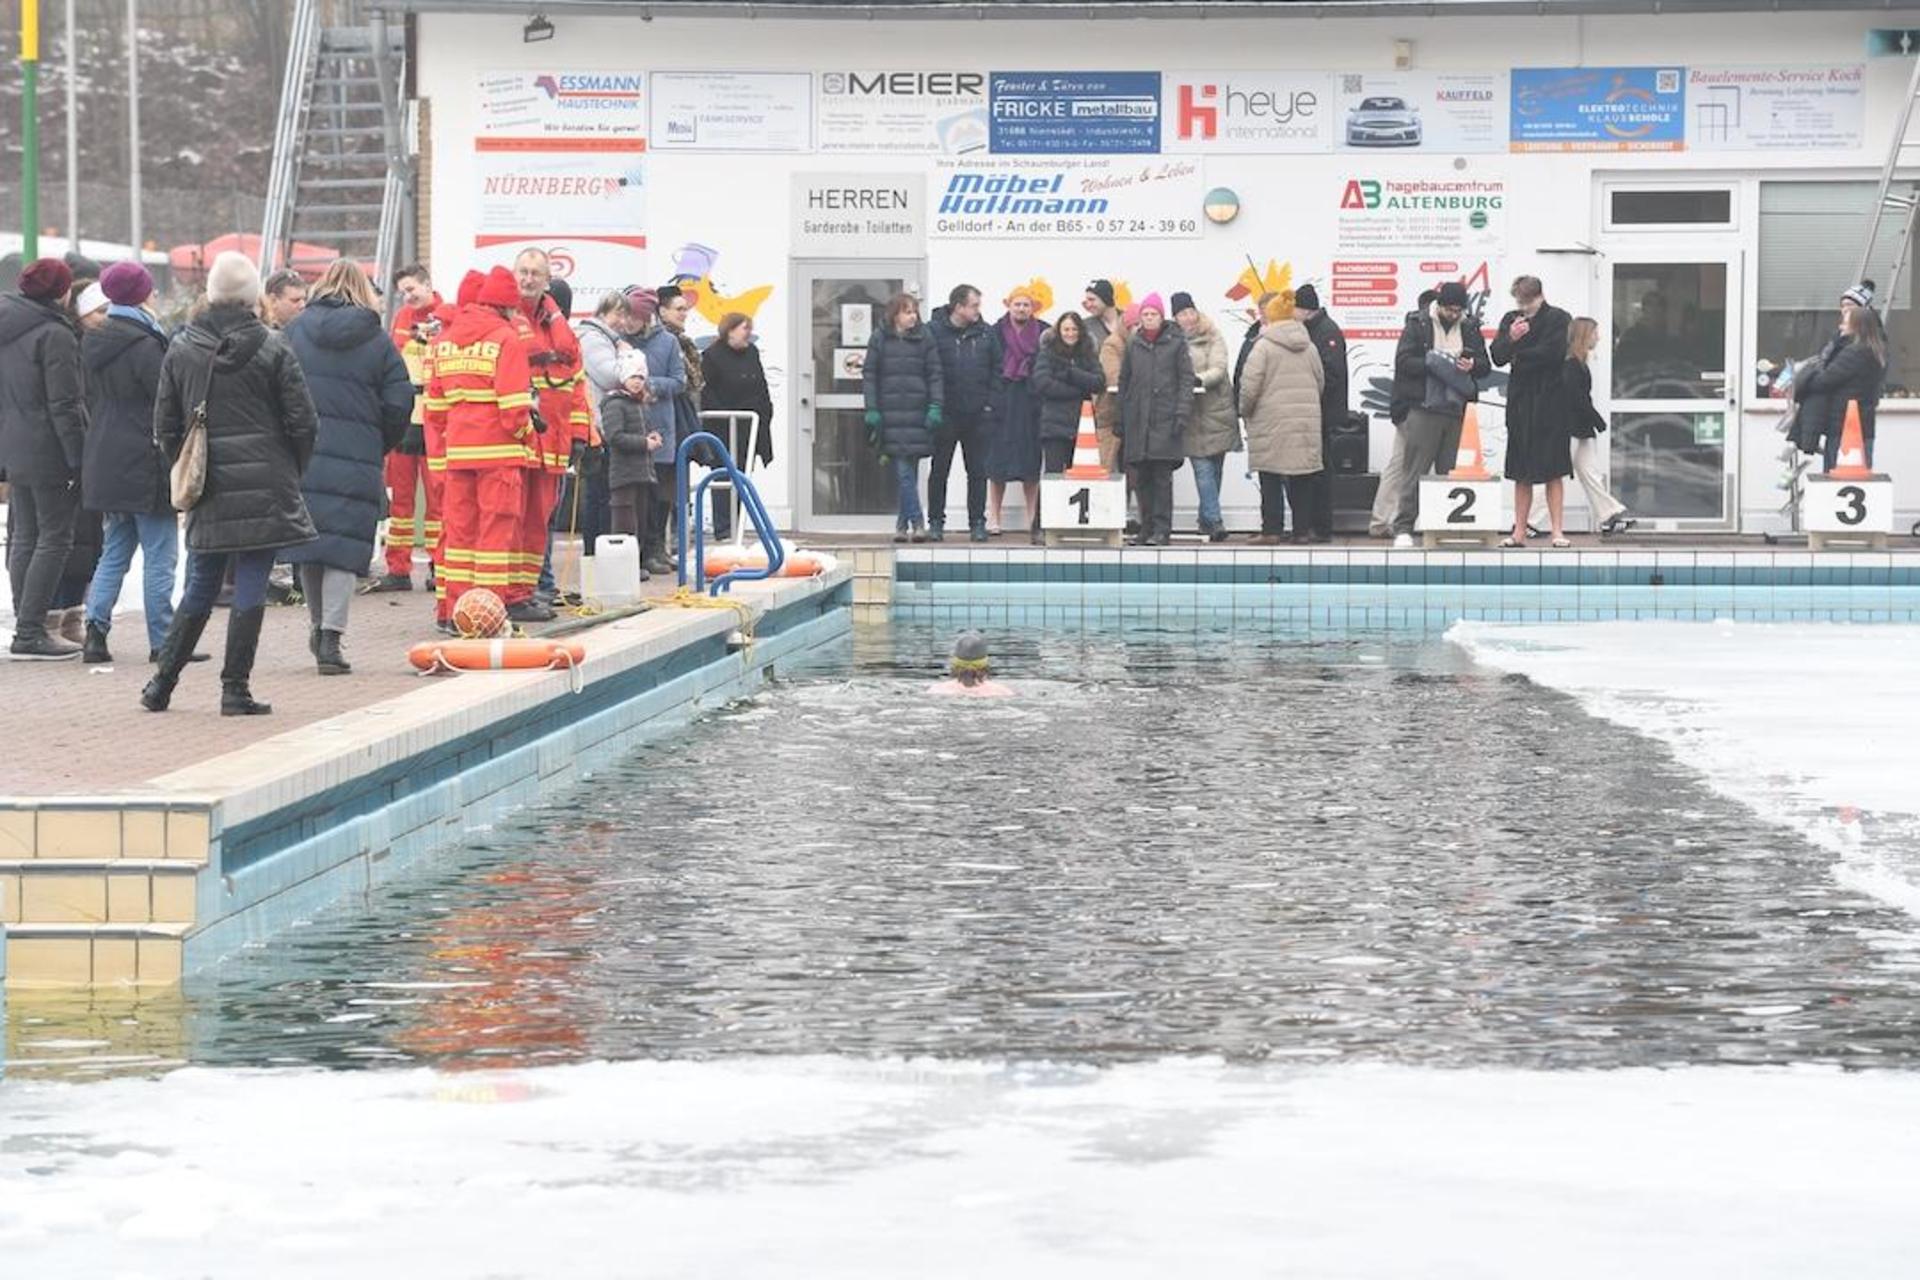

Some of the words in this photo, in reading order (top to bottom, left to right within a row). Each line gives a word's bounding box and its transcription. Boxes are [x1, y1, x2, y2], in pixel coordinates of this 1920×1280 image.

[559, 75, 642, 90] ESSMANN
[1690, 69, 1825, 83] Bauelemente-Service
[1828, 68, 1862, 82] Koch
[849, 72, 984, 95] MEIER
[994, 79, 1036, 92] Fenster
[1436, 89, 1494, 101] KAUFFELD
[557, 99, 639, 110] HAUSTECHNIK
[992, 101, 1067, 117] FRICKE
[1076, 103, 1153, 115] metallbau
[1225, 84, 1317, 123] heye
[1226, 126, 1318, 139] international
[947, 174, 1064, 193] Möbel
[1080, 174, 1134, 193] Wohnen
[1386, 180, 1503, 194] hagebaucentrum
[808, 189, 908, 209] HERREN
[1386, 196, 1502, 209] ALTENBURG
[804, 220, 860, 234] Garderobe
[866, 220, 913, 234] Toiletten
[937, 219, 993, 232] Gelldorf
[1006, 220, 1025, 232] An
[1029, 220, 1052, 232] der
[1056, 220, 1084, 232] B65
[1108, 220, 1125, 232] 57
[1129, 220, 1146, 232] 24
[1158, 220, 1175, 232] 39
[1179, 220, 1196, 232] 60
[1069, 487, 1090, 525] 1
[1446, 486, 1477, 524] 2
[1835, 485, 1868, 526] 3
